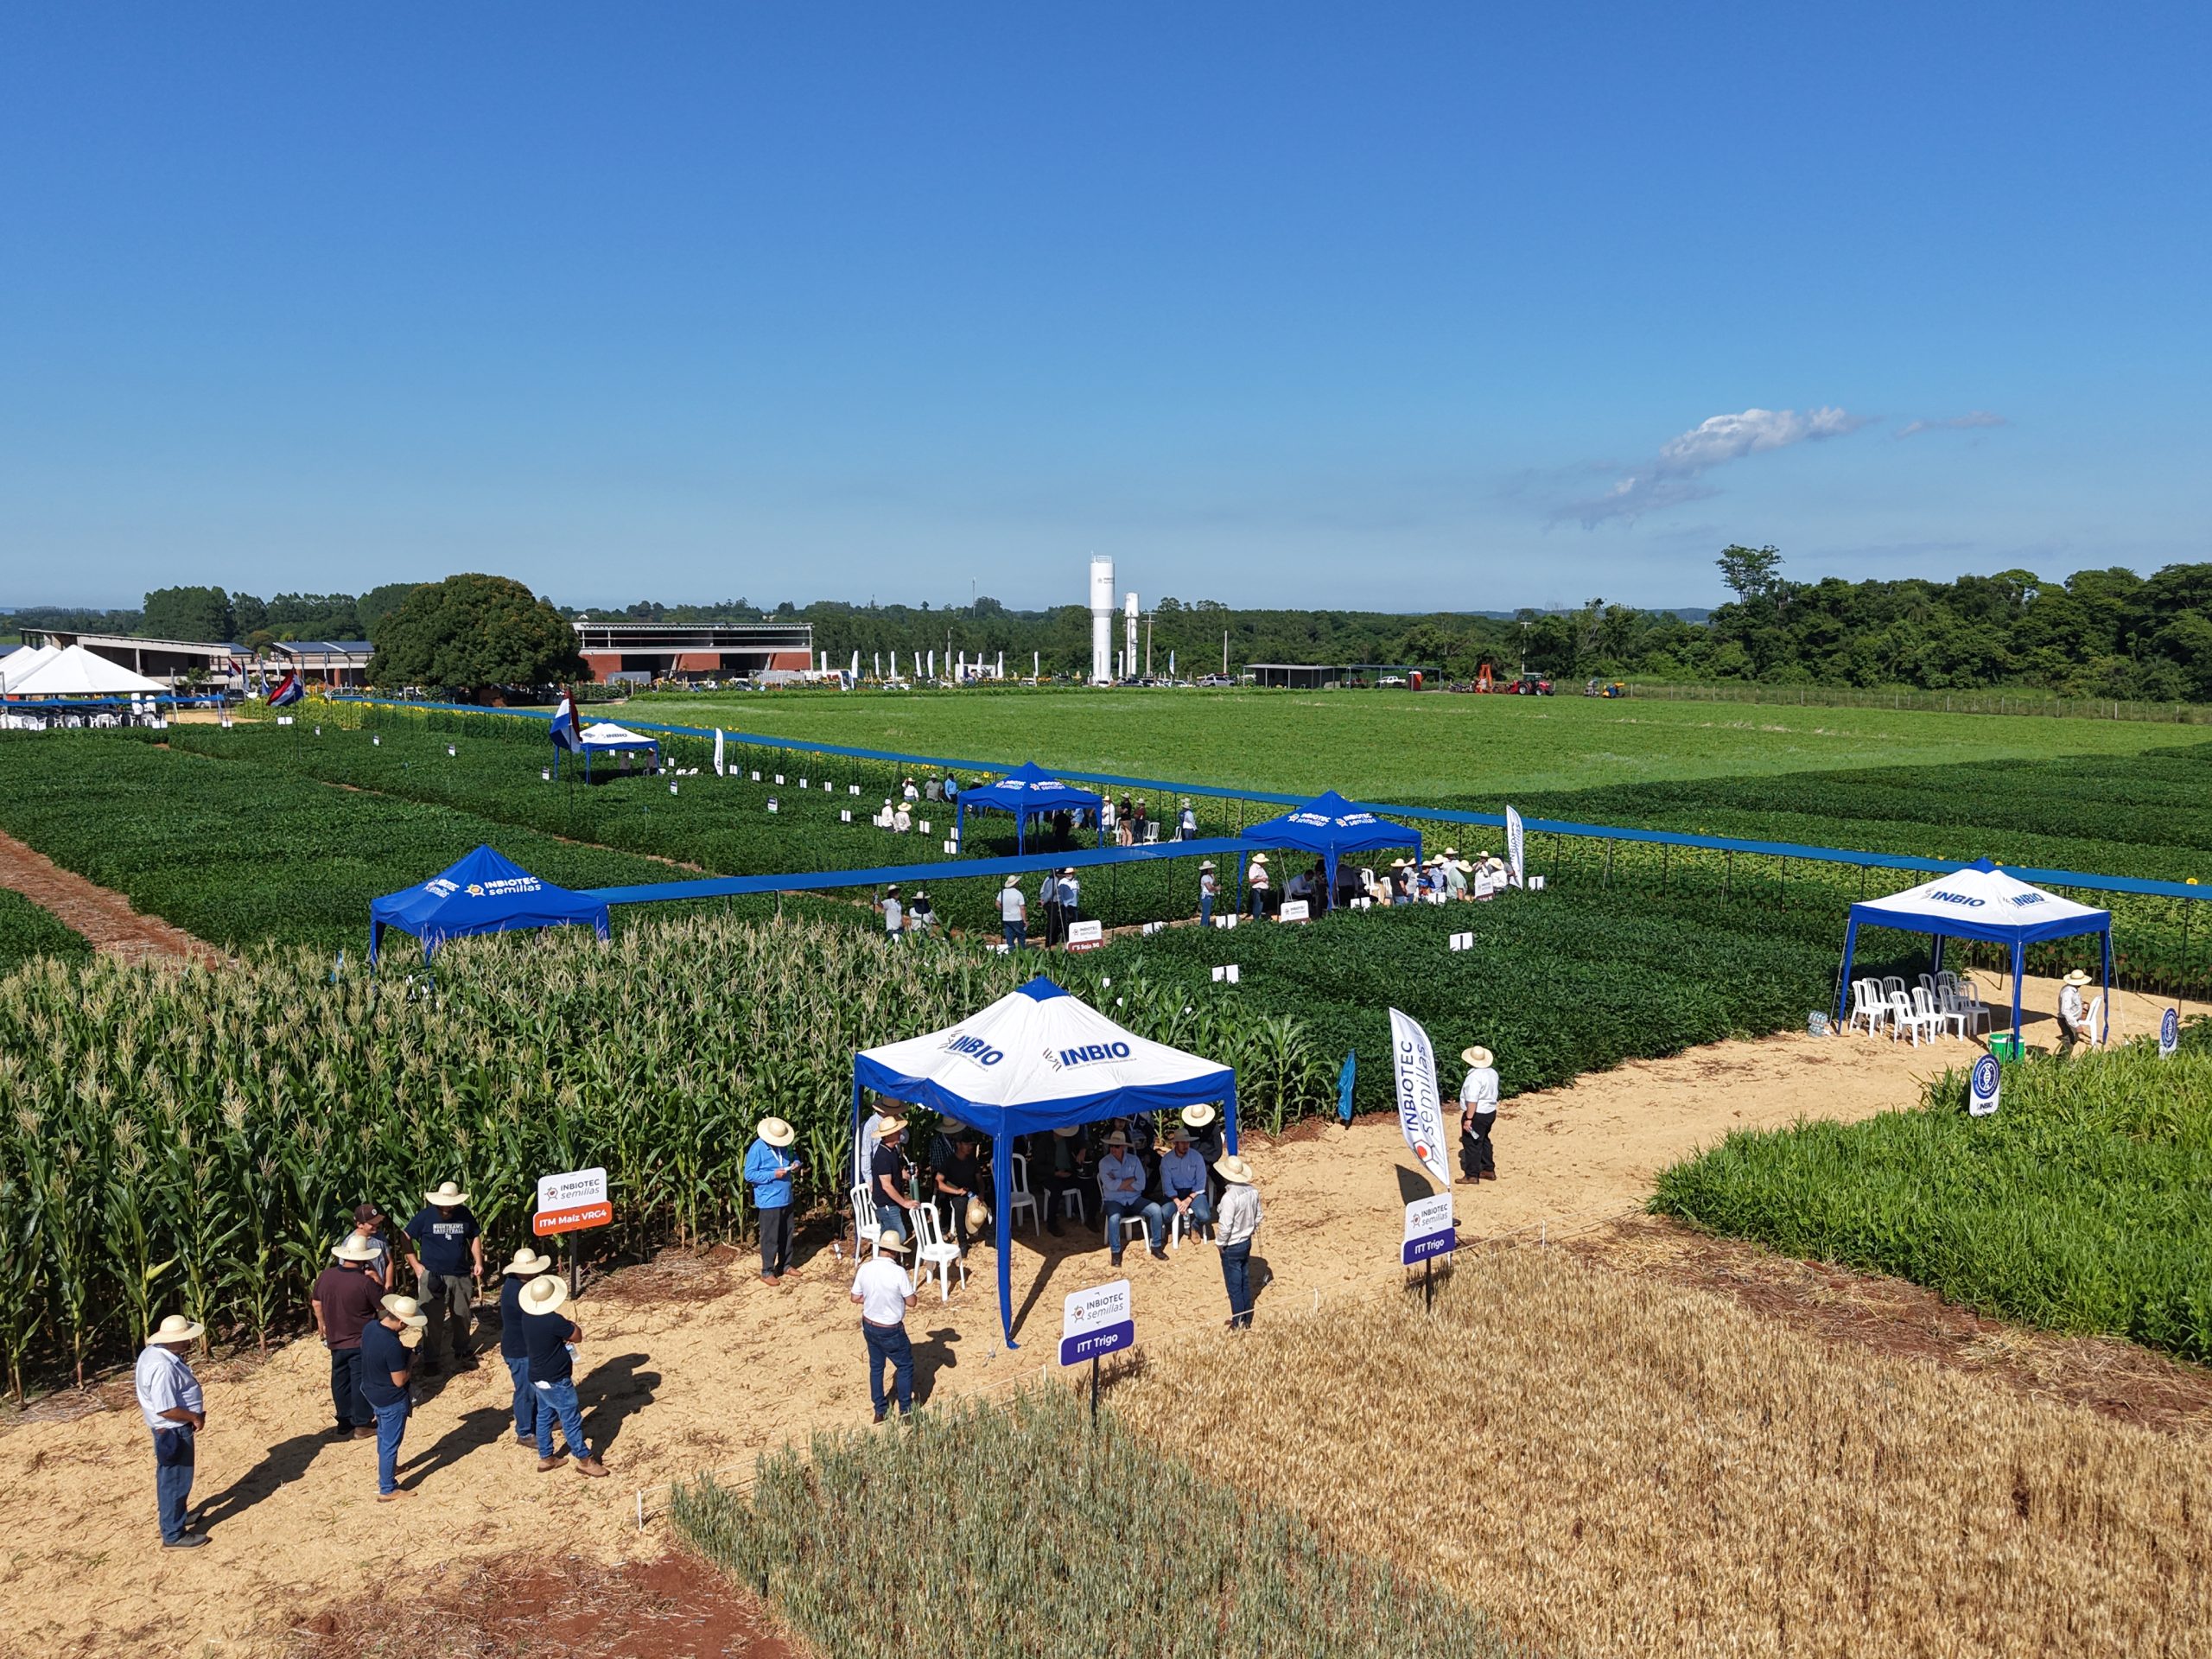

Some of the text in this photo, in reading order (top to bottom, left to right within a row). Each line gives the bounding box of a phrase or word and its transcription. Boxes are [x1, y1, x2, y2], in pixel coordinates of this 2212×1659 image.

[484, 877, 538, 889] INBIOTEC
[489, 884, 542, 896] semillas
[1930, 891, 1986, 907] INBIO
[2012, 893, 2045, 906] INBIO
[950, 1035, 1004, 1066] INBIO
[1059, 1041, 1130, 1067] INBIO
[1401, 1040, 1419, 1131] INBIOTEC
[1415, 1044, 1434, 1135] semillas
[560, 1179, 601, 1192] INBIOTEC
[560, 1186, 600, 1199] semillas
[539, 1209, 607, 1228] ITM Maíz VRG4
[1421, 1204, 1448, 1217] INBIOTEC
[1421, 1212, 1448, 1226] semillas
[1414, 1238, 1445, 1255] ITT Trigo
[1086, 1293, 1124, 1310] INBIOTEC
[1087, 1302, 1124, 1320] semillas
[1077, 1333, 1118, 1353] ITT Trigo
